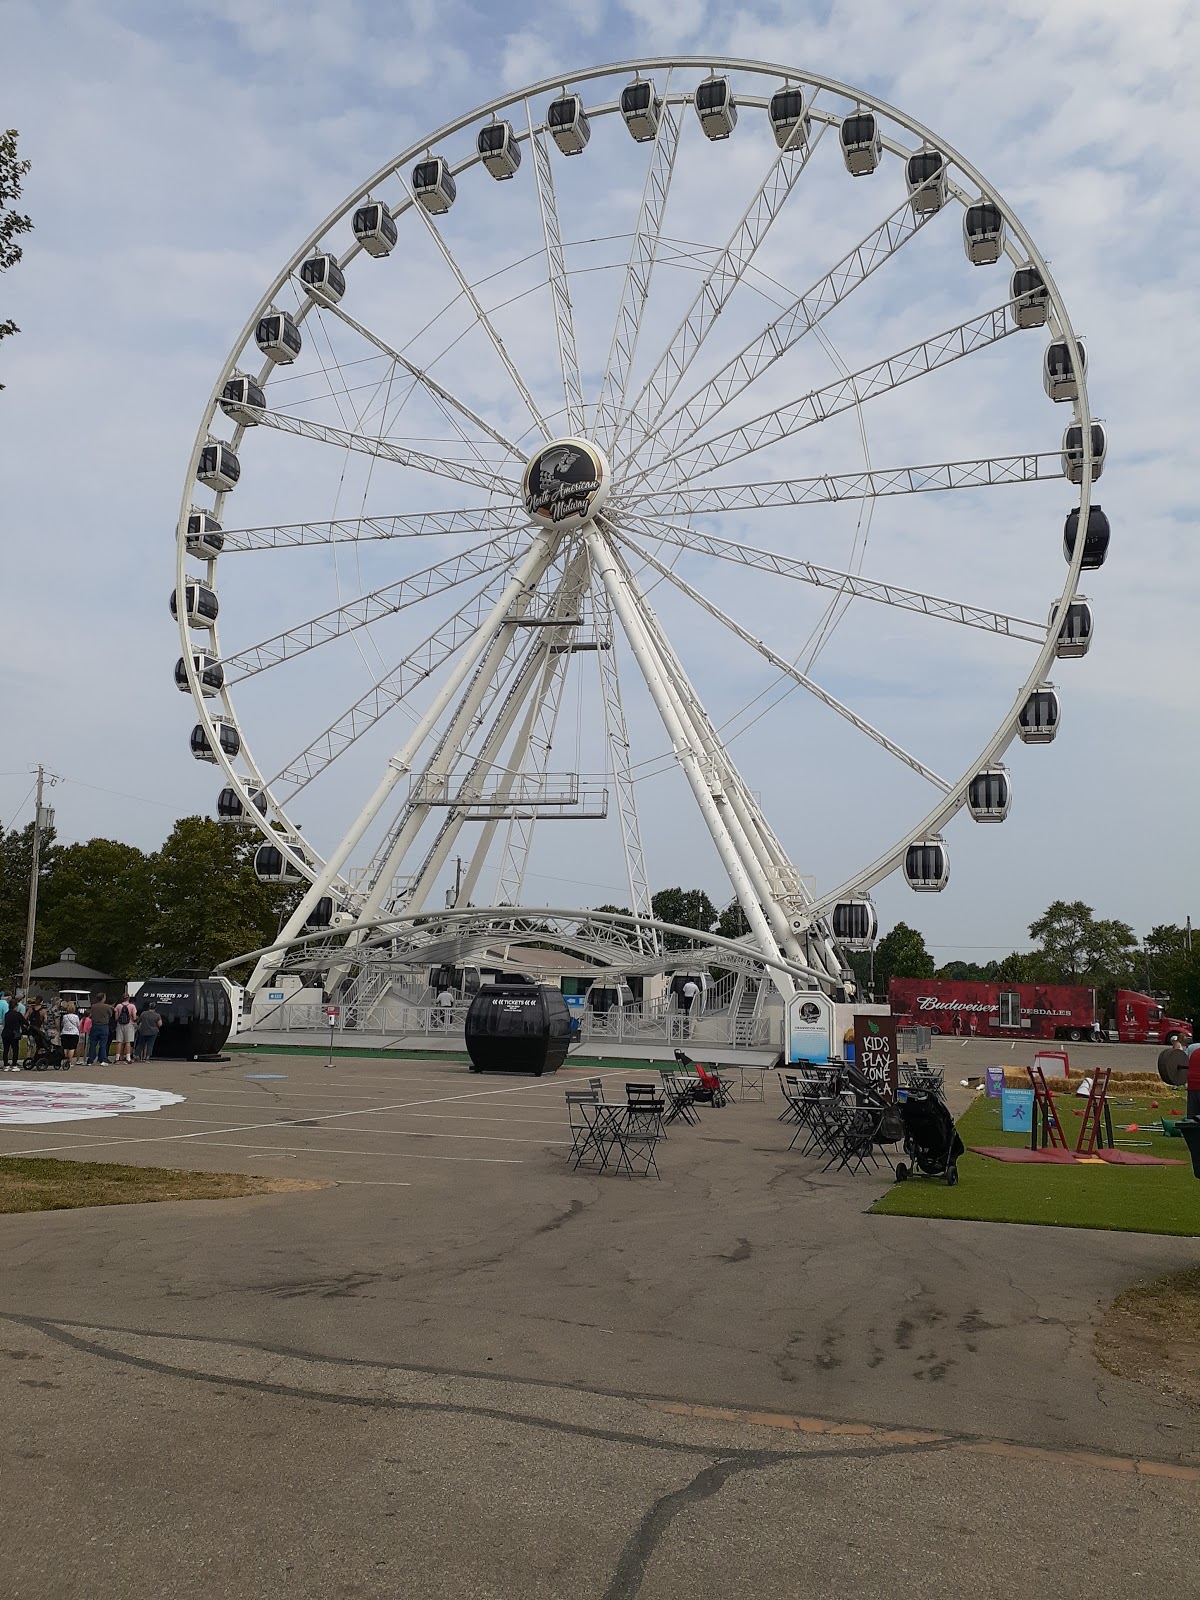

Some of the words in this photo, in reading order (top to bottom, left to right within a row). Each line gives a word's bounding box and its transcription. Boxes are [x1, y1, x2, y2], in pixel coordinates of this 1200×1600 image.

[526, 490, 551, 512] North
[551, 481, 598, 500] American
[550, 499, 588, 521] Midway
[916, 996, 1000, 1012] Budweiser
[1020, 1008, 1072, 1016] DESDALES
[863, 1036, 889, 1052] KIDS
[862, 1052, 894, 1071] PLAY
